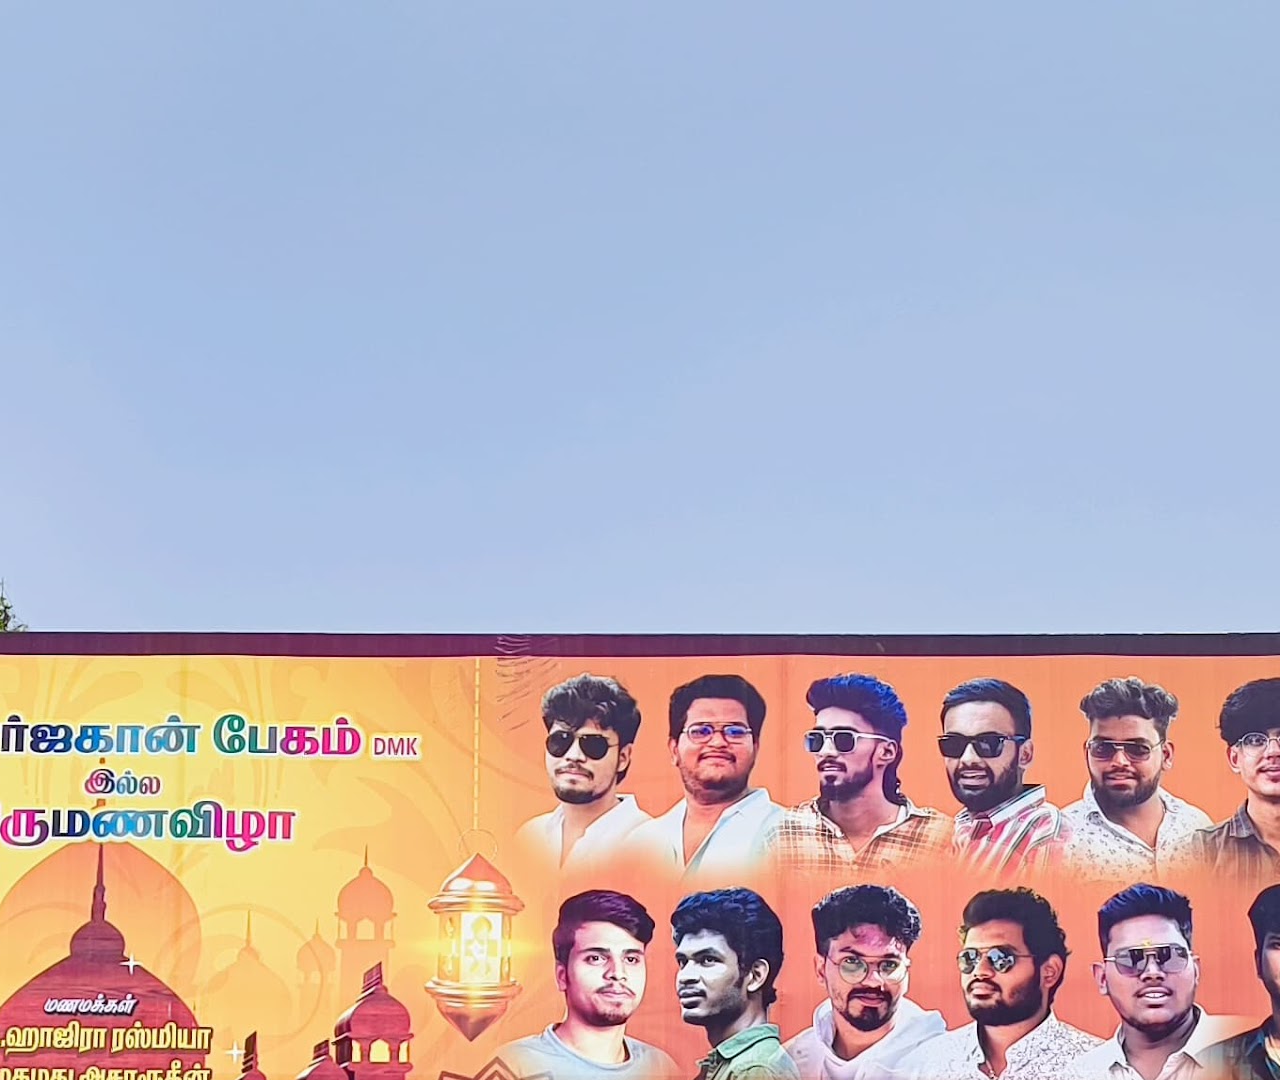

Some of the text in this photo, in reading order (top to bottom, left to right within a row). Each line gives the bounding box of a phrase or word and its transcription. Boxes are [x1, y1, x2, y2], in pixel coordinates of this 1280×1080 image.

[213, 714, 361, 755] பேகம்
[374, 737, 418, 756] DMK
[84, 768, 161, 794] இல்ல
[43, 993, 138, 1014] மணமக்கள்
[111, 1020, 212, 1053] ரஸ்மியா
